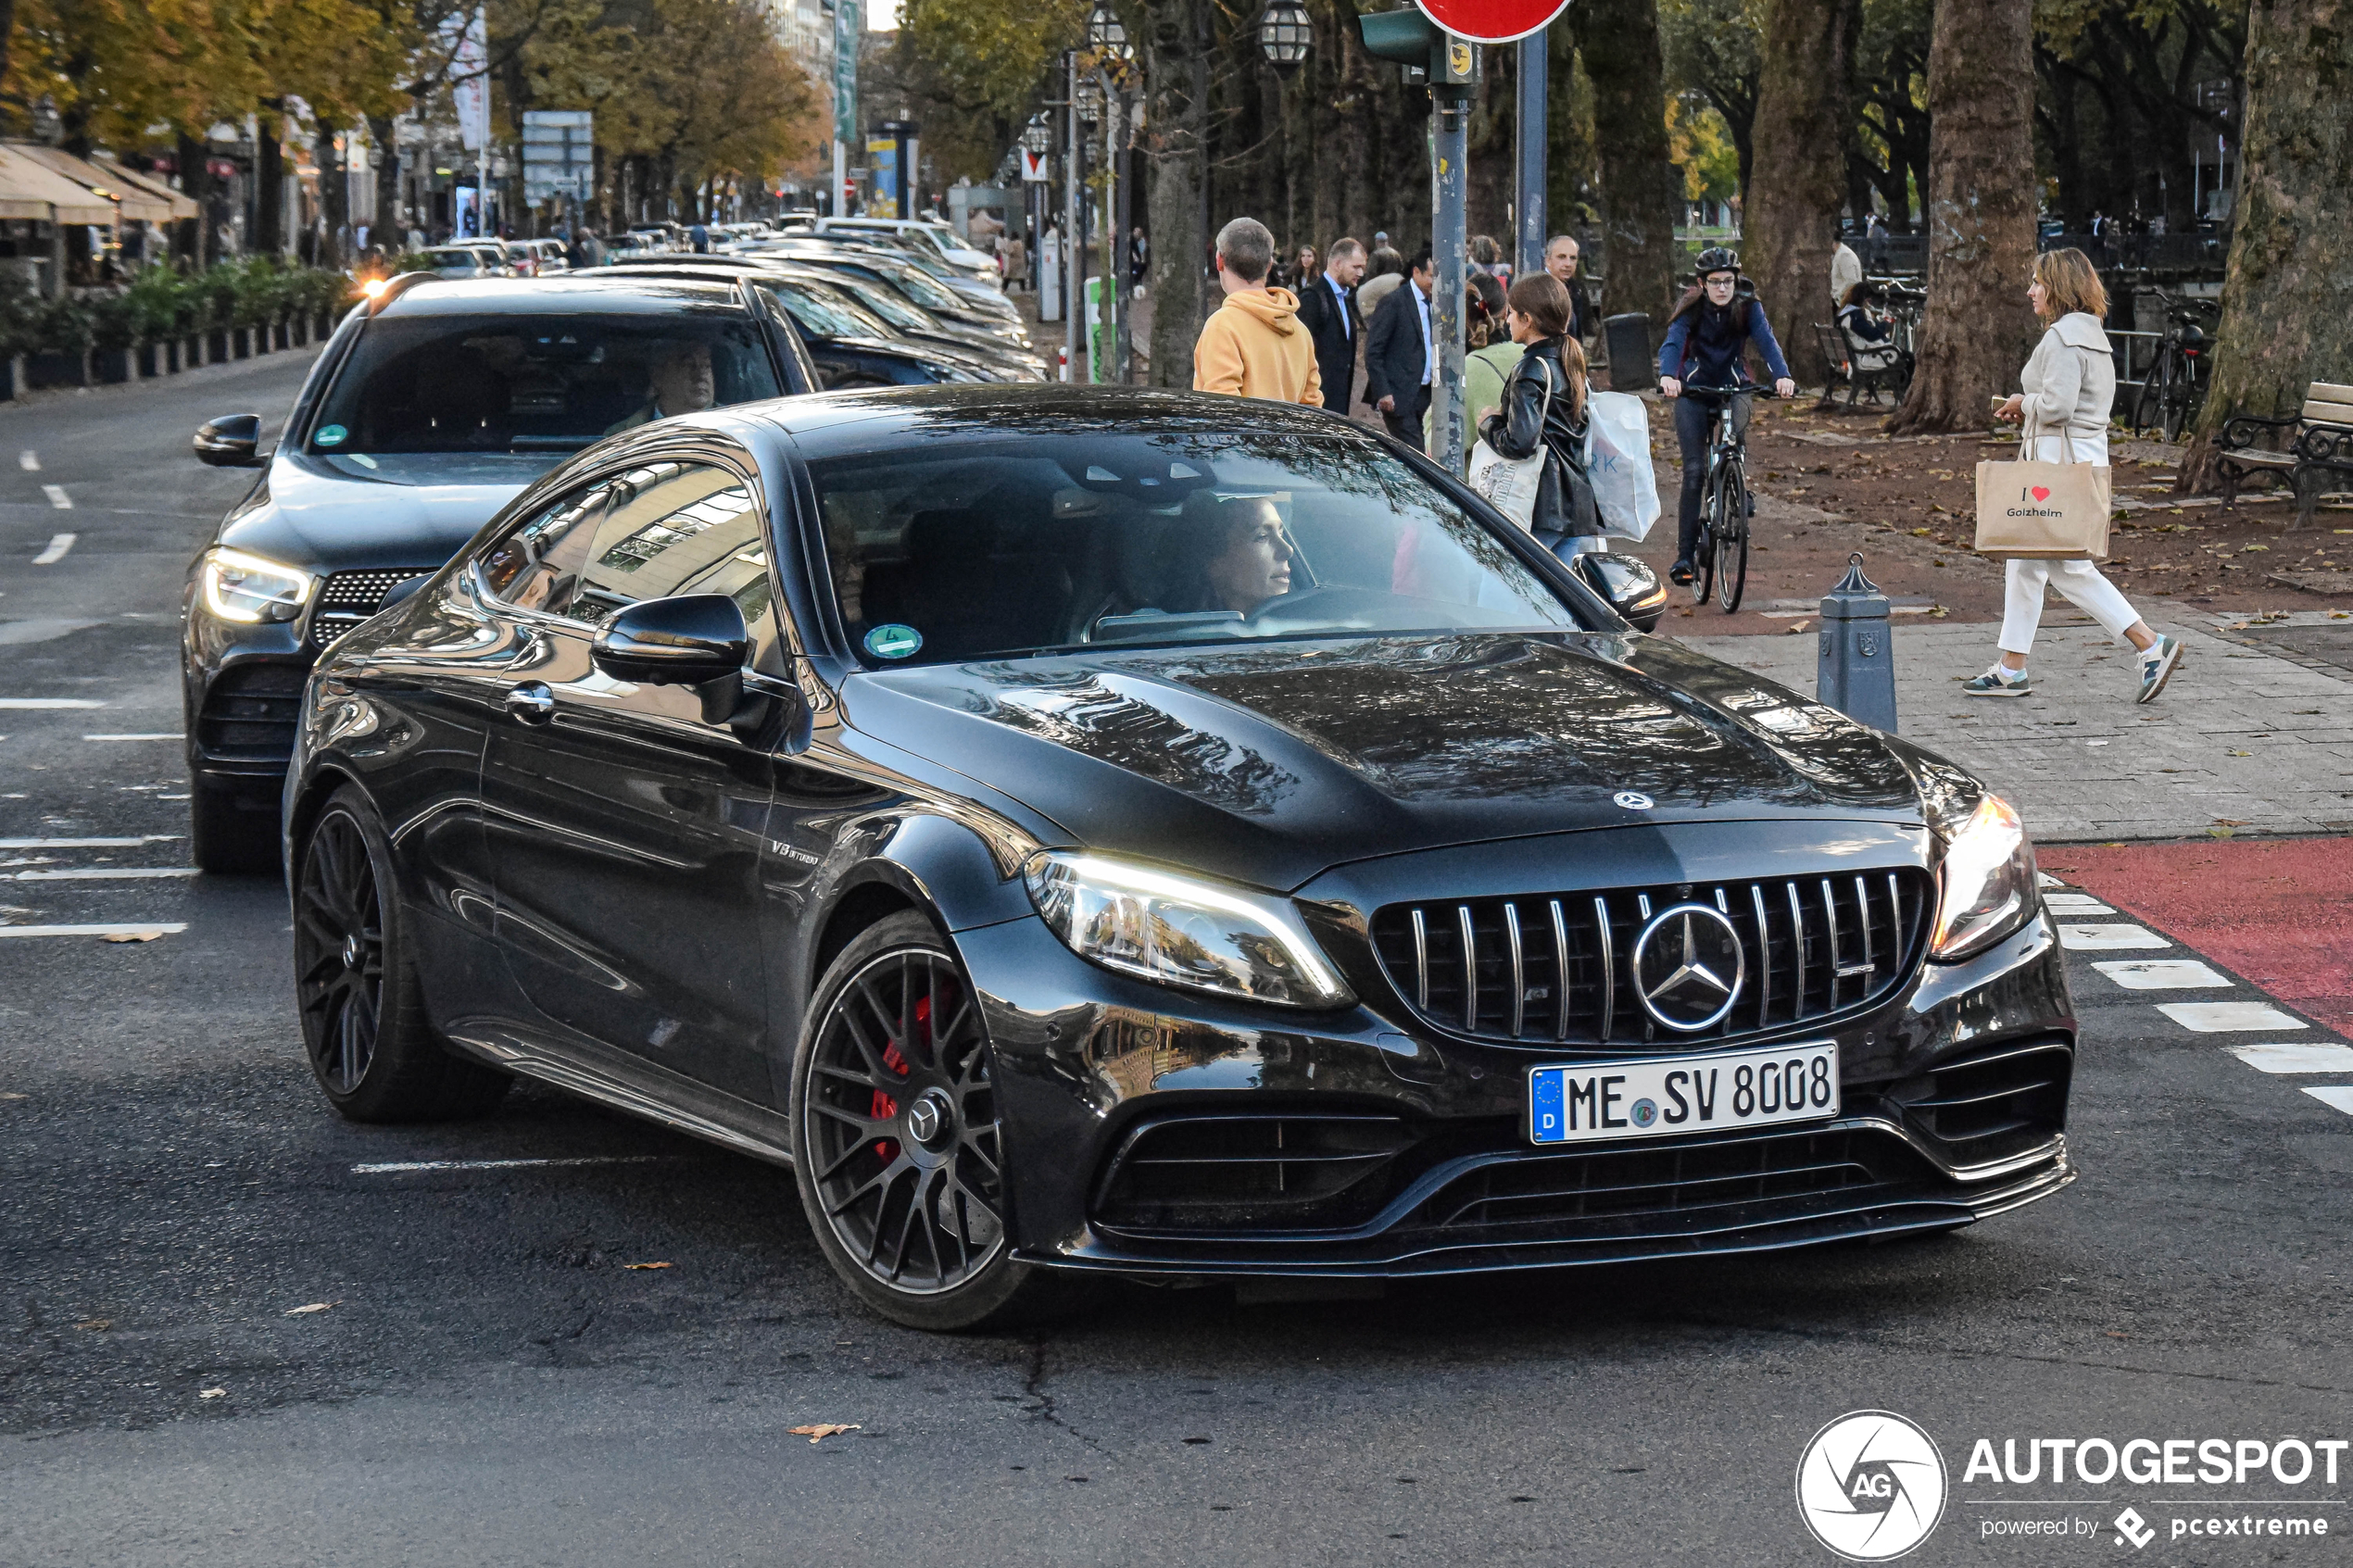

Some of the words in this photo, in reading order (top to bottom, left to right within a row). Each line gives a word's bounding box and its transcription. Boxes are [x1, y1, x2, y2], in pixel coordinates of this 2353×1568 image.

[2021, 487, 2027, 502] I
[2007, 508, 2063, 518] Golzheim
[772, 840, 791, 856] V8
[1568, 1075, 1628, 1131] ME
[1664, 1068, 1718, 1124] SV
[1732, 1054, 1831, 1119] 8008
[1542, 1113, 1554, 1129] D
